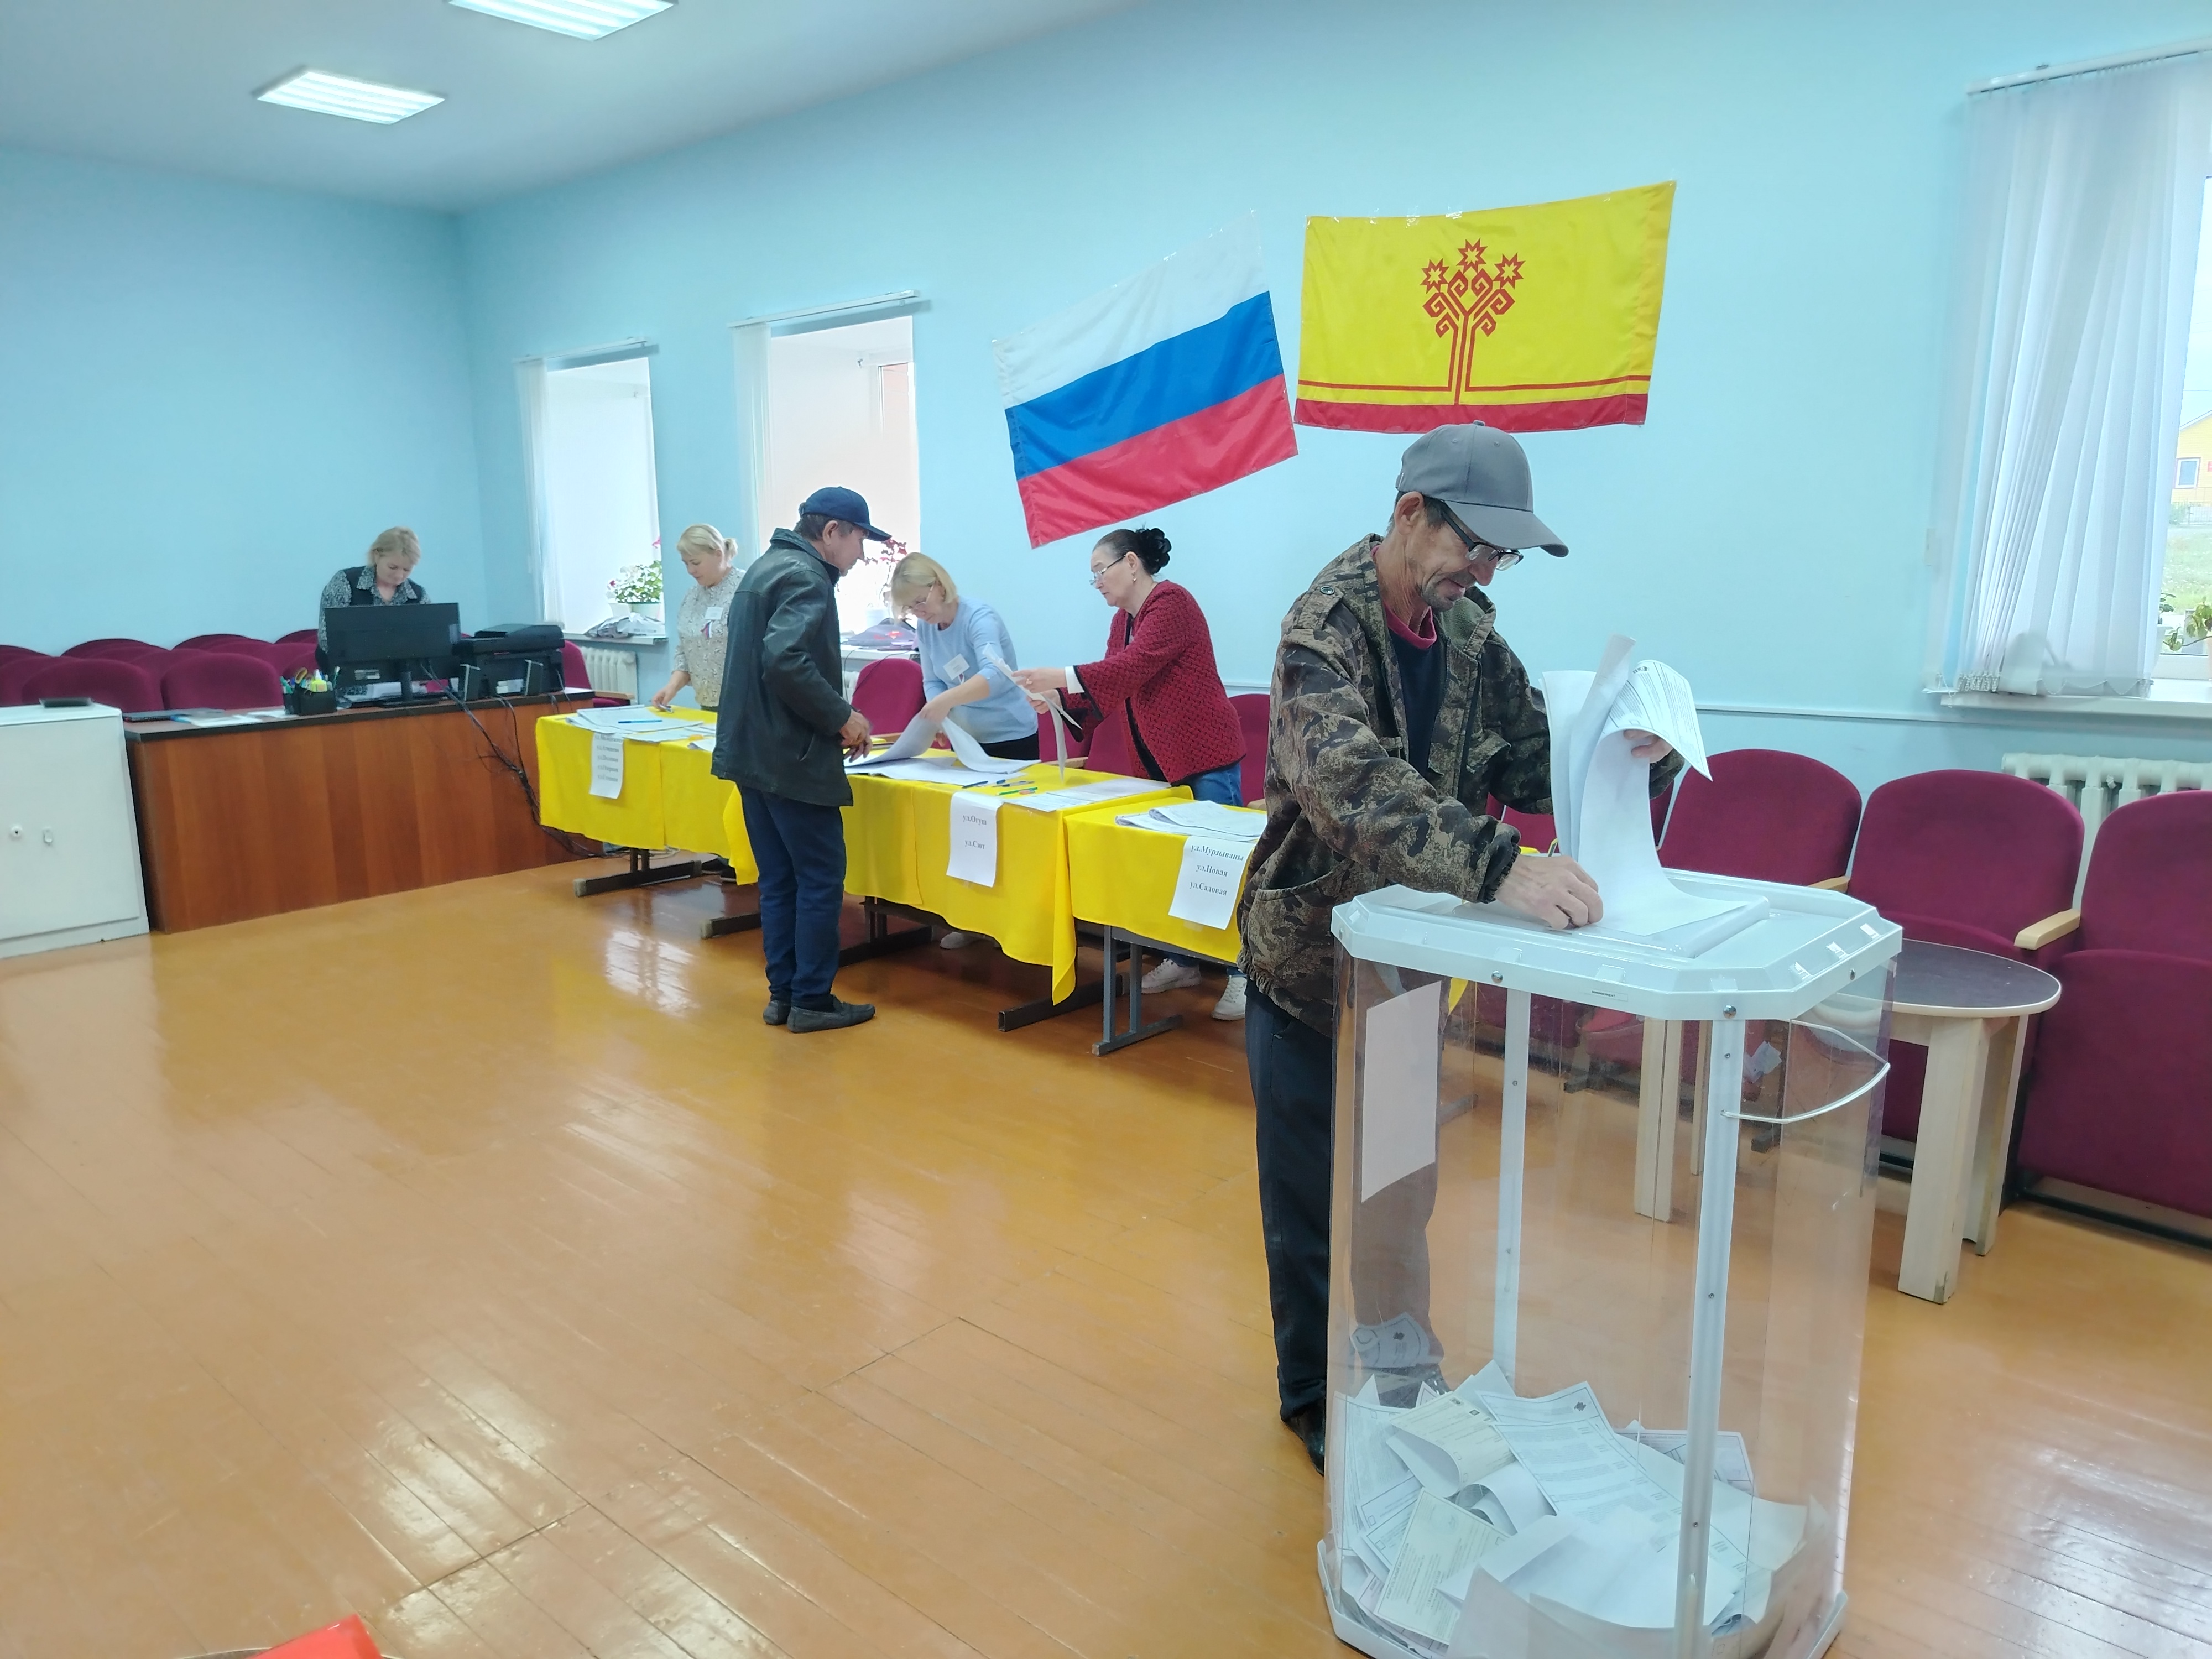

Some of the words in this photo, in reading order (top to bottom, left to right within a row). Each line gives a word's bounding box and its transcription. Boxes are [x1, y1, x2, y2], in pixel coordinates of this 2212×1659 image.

[962, 815, 987, 825] ул.Огуш
[1190, 844, 1244, 862] ул.Мурзываны
[1196, 864, 1228, 877] ул.Новая
[1189, 881, 1228, 896] ул.Садовая
